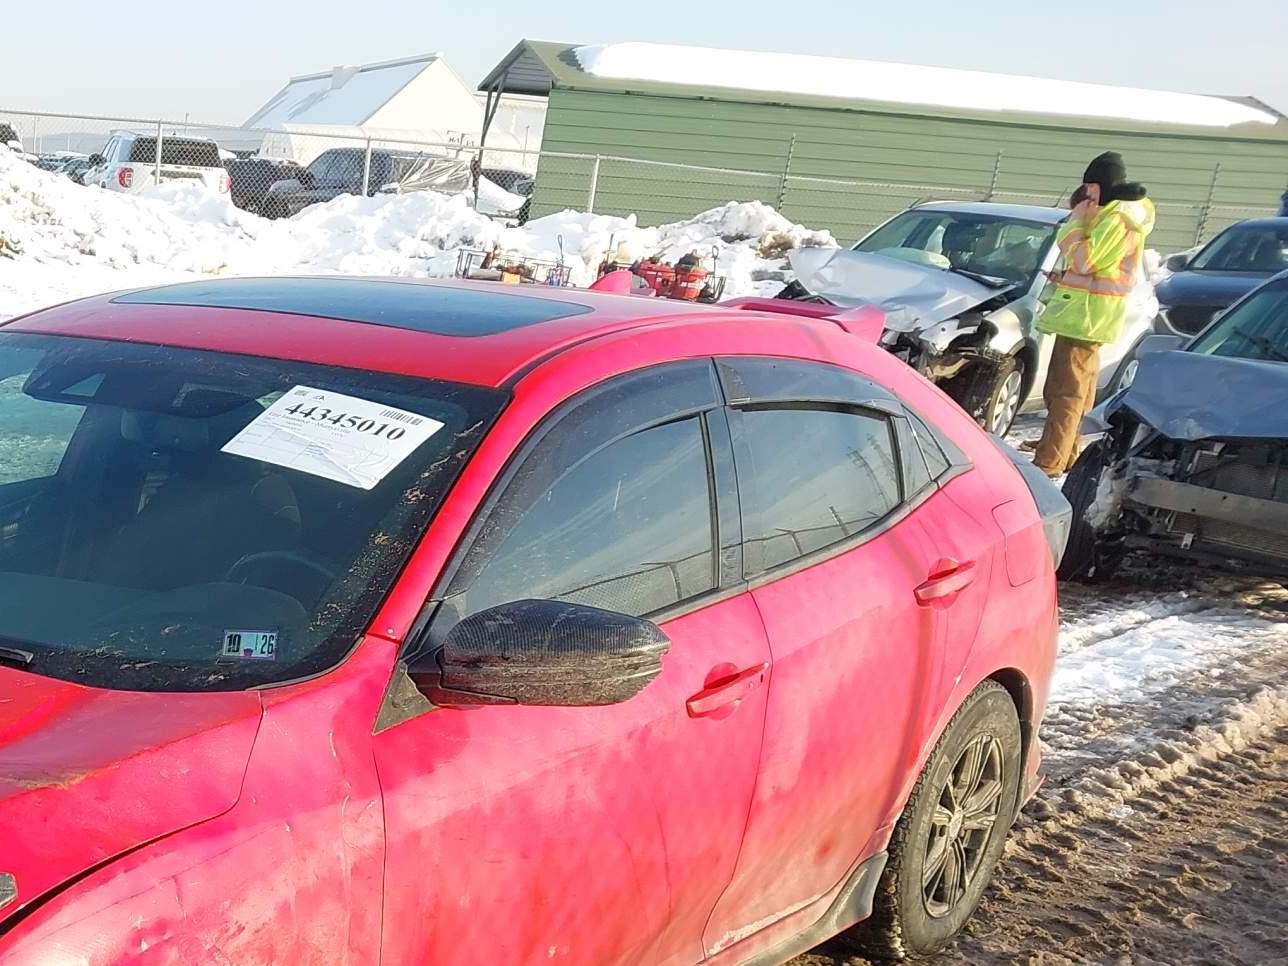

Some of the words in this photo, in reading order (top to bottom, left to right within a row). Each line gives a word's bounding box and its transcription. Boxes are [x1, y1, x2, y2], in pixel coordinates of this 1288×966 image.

[284, 402, 406, 441] 44345010
[227, 633, 242, 652] 10
[260, 635, 275, 655] 26
